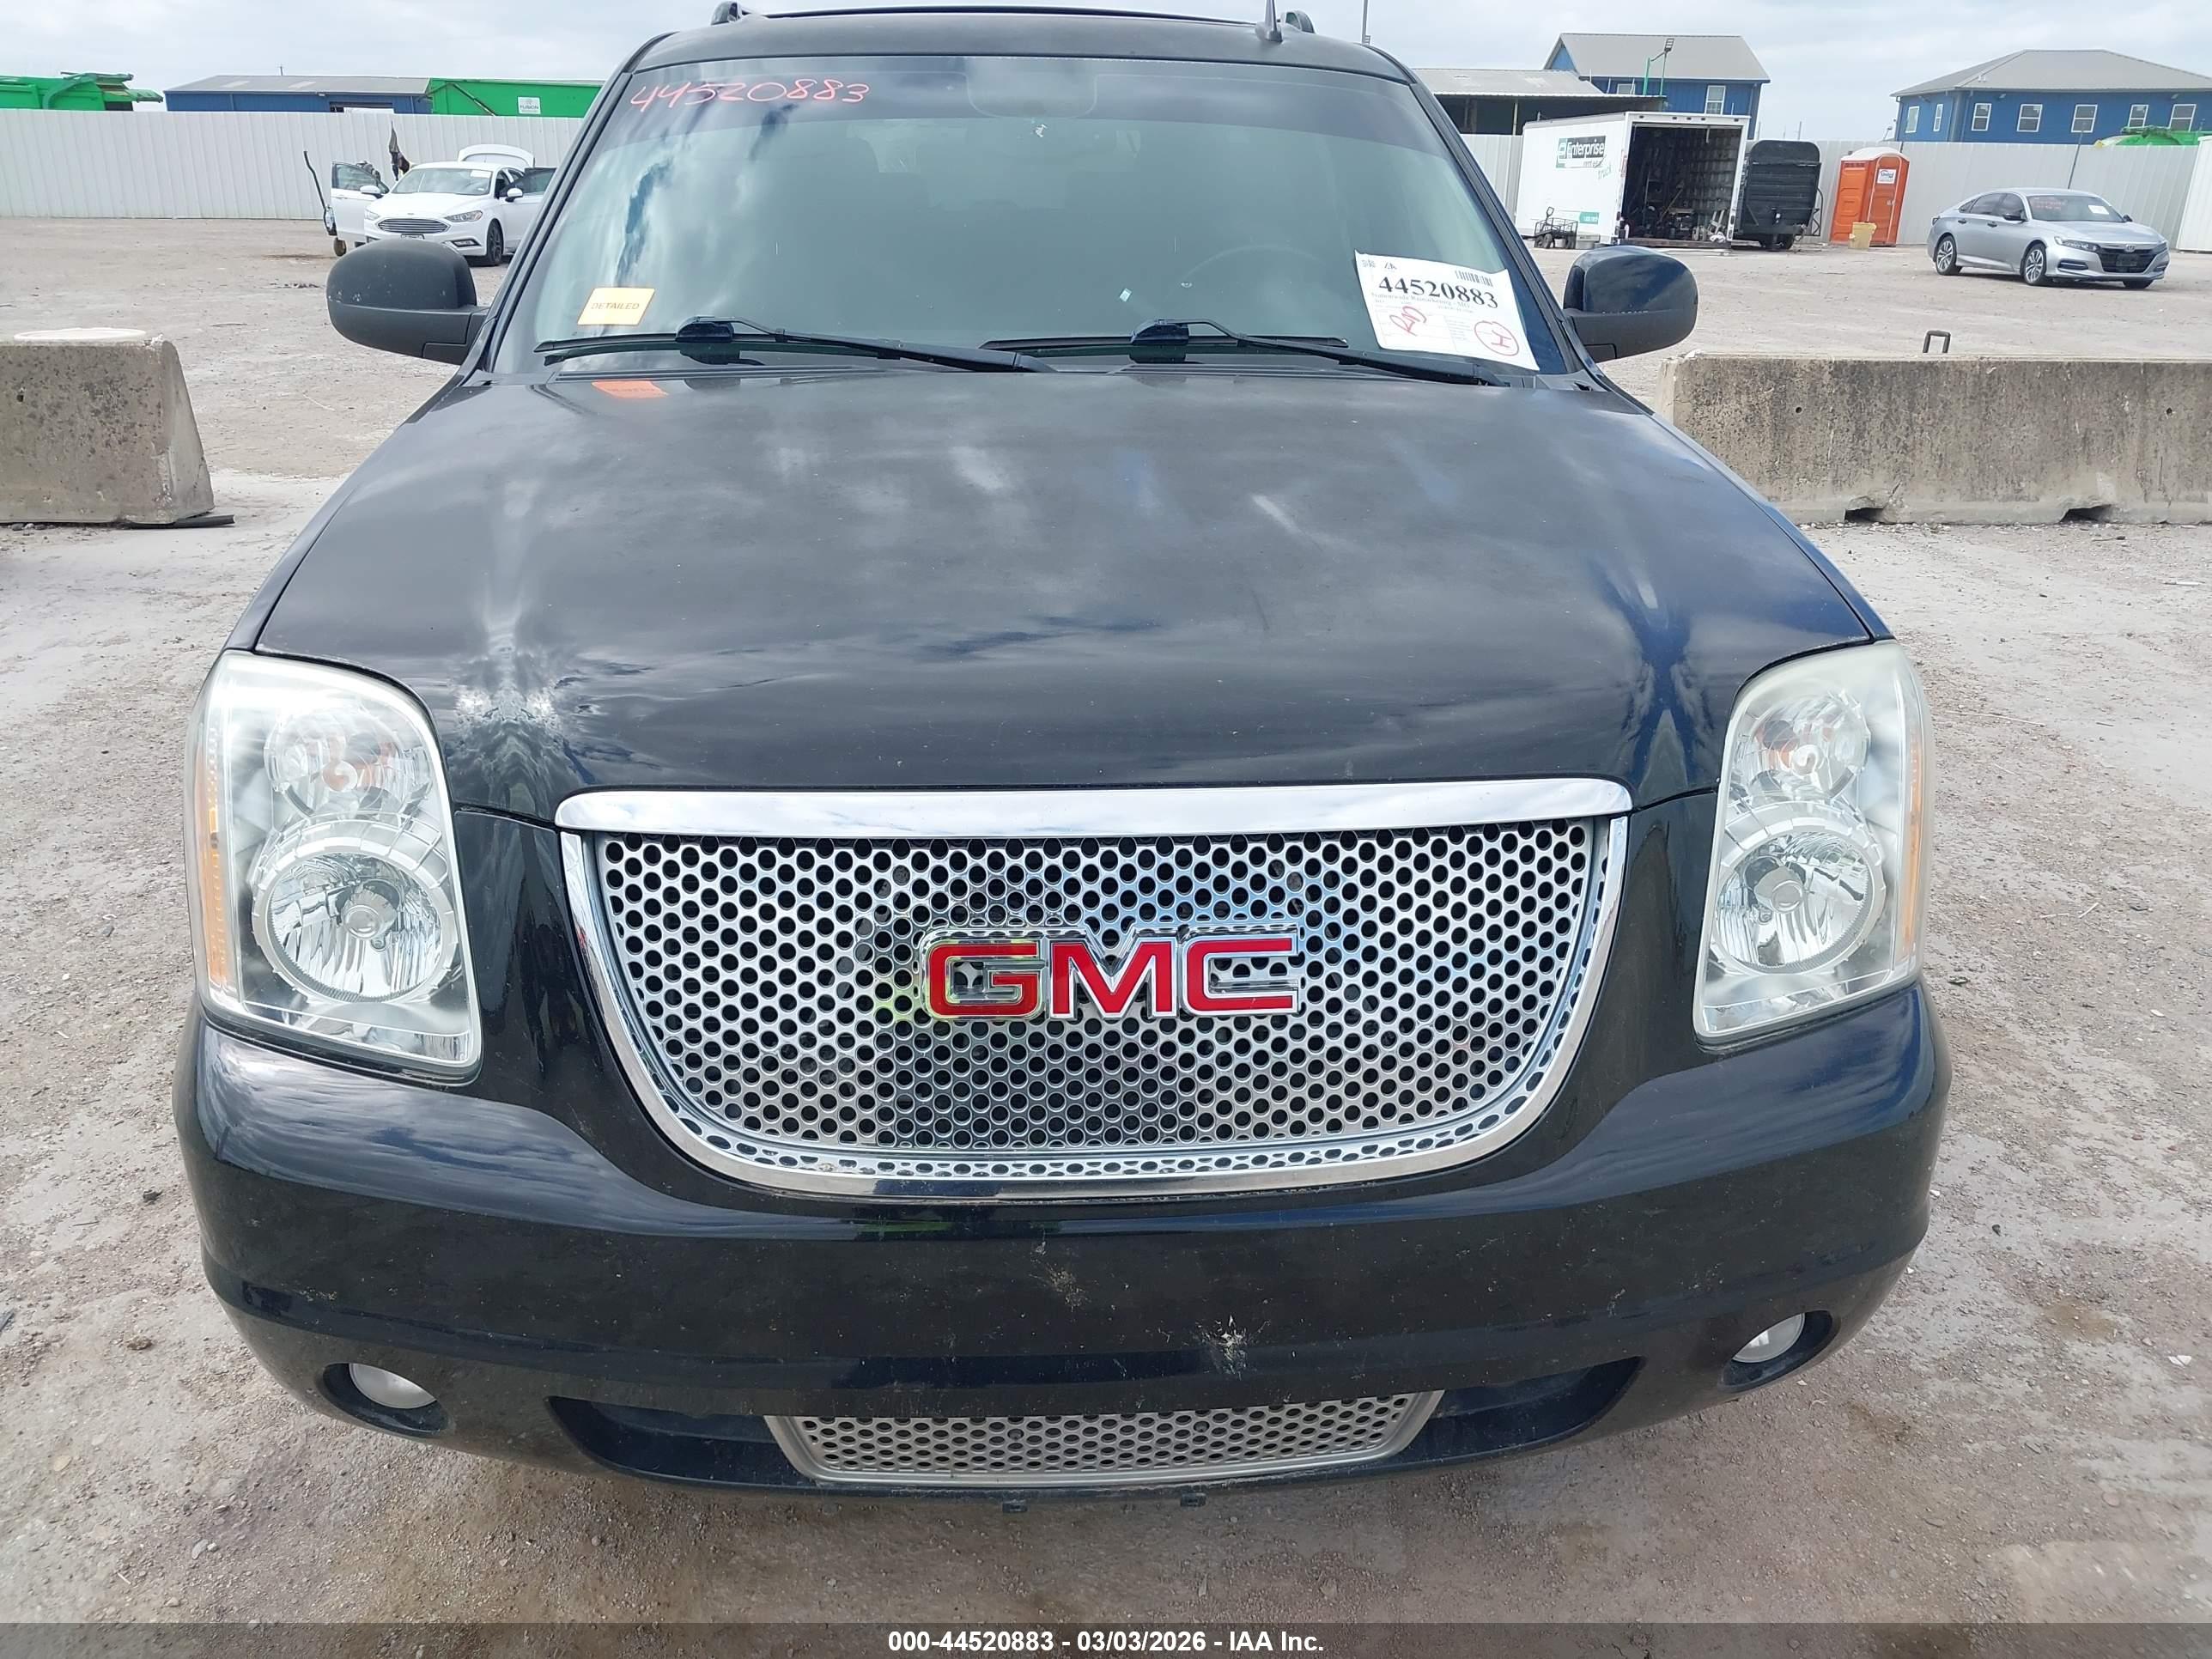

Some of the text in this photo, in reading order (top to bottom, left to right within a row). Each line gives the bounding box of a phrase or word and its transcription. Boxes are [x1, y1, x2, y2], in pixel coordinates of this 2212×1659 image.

[630, 79, 870, 112] 44520883
[1566, 138, 1605, 158] Enterprise
[1378, 276, 1498, 309] 44520883
[921, 928, 1300, 1019] GMC
